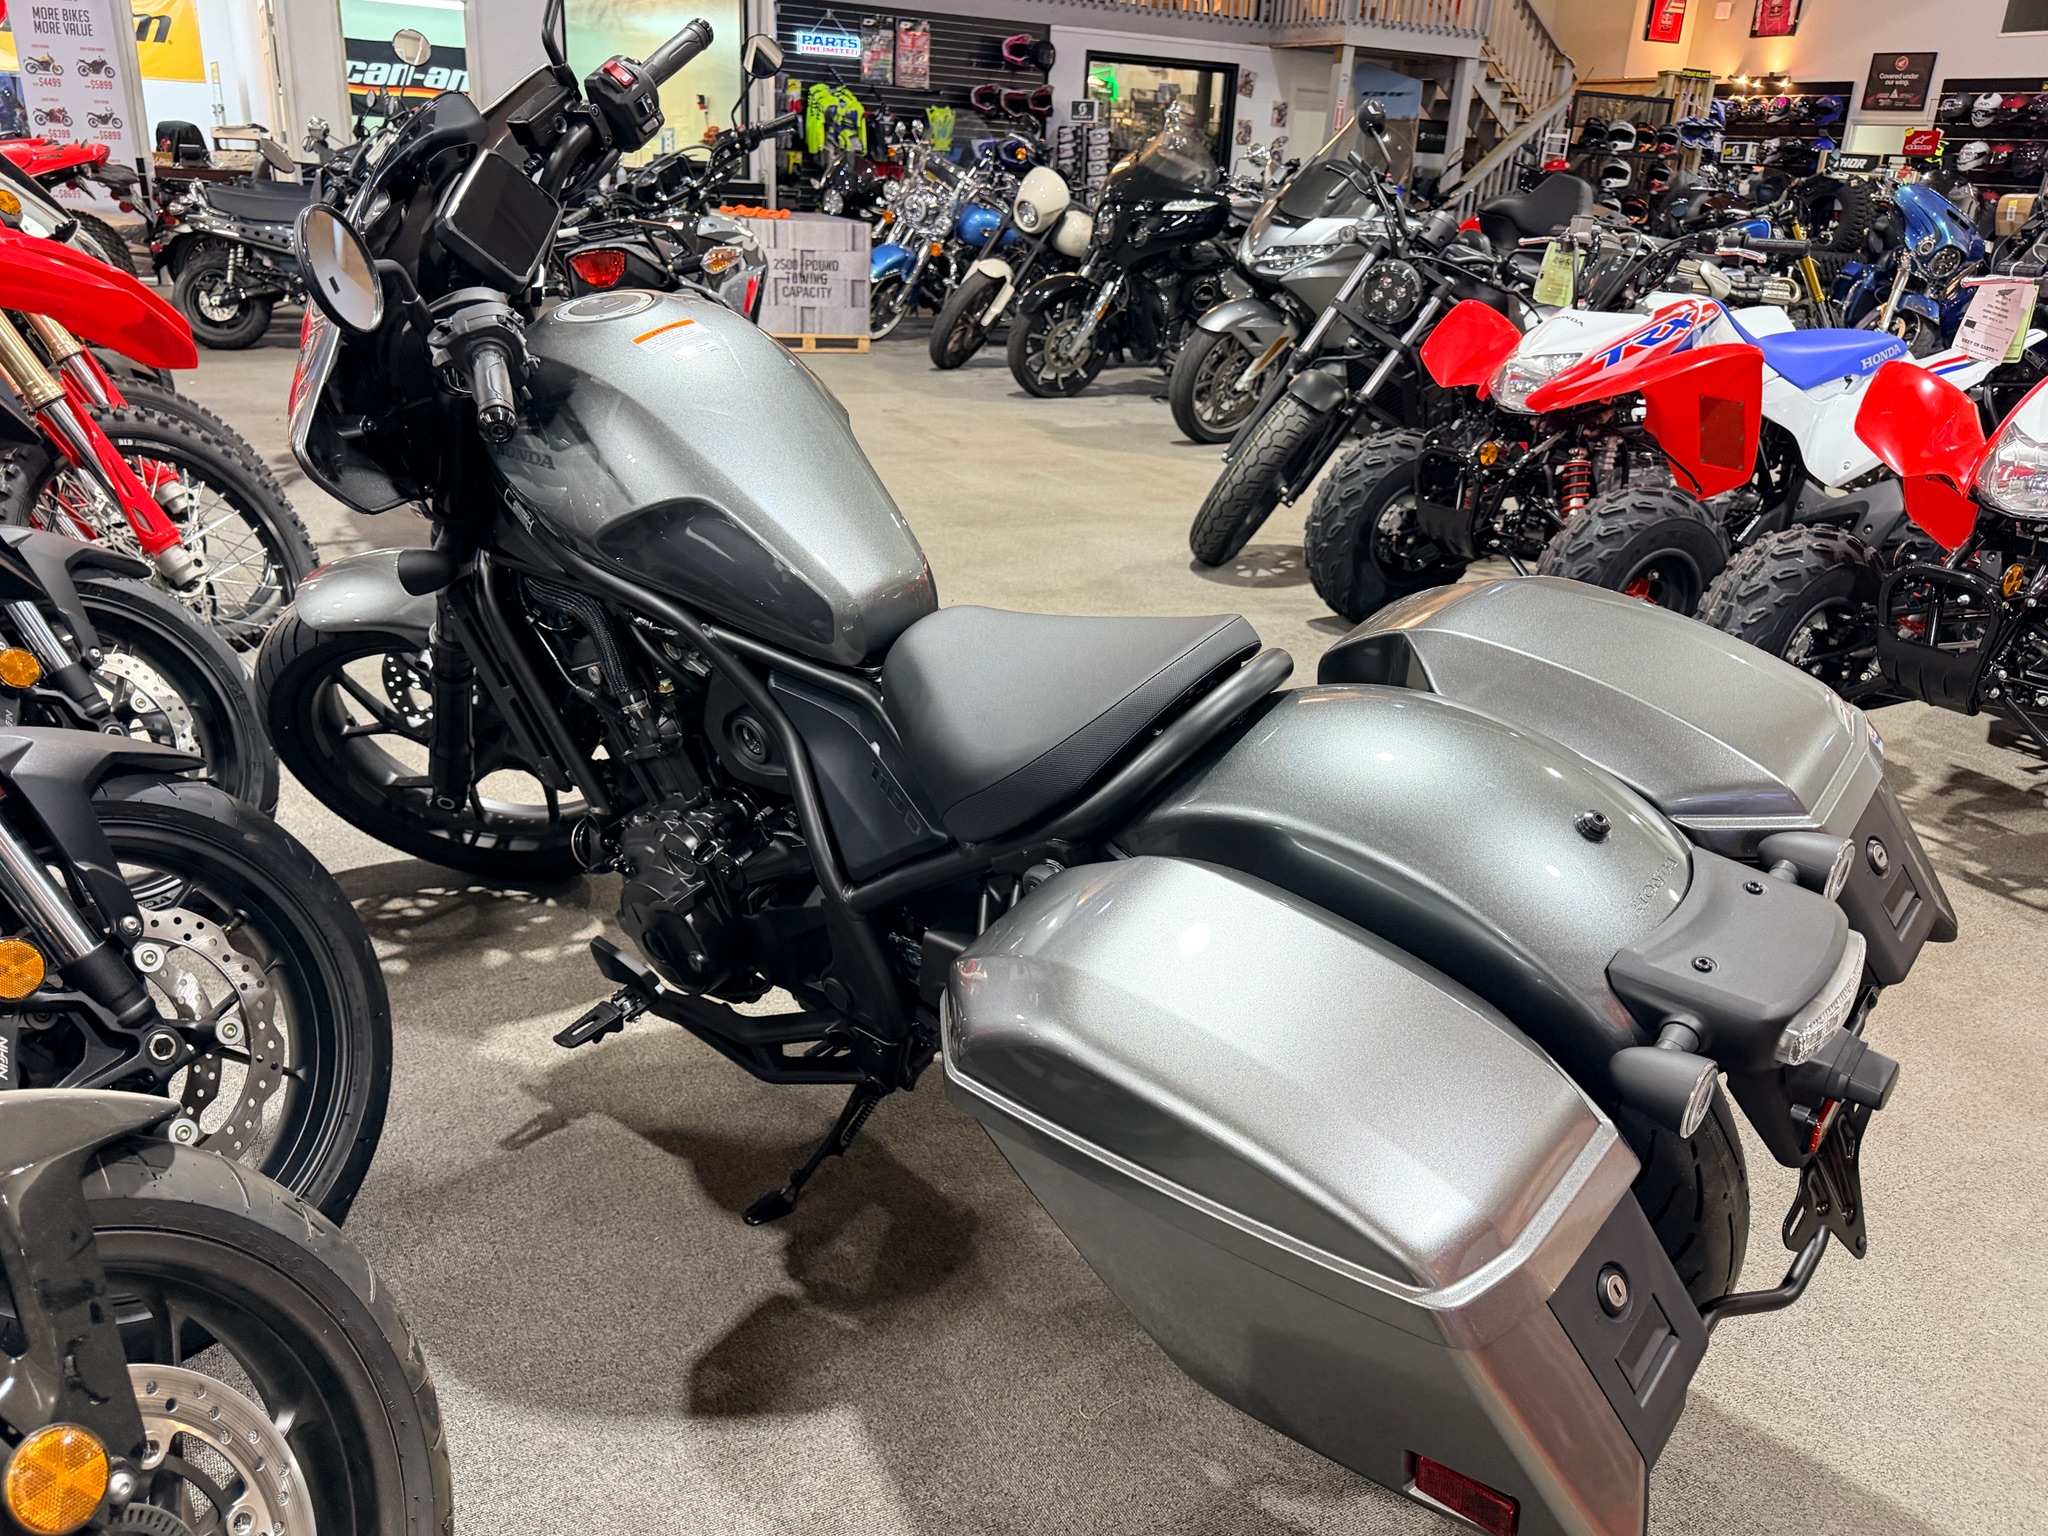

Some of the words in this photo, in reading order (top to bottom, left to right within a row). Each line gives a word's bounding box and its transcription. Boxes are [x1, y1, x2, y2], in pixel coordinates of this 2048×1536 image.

[32, 6, 60, 20] MORE
[62, 8, 90, 23] BIKES
[33, 20, 61, 35] MORE
[62, 22, 94, 37] VALUE
[801, 45, 858, 55] UNLIMITED
[802, 35, 858, 48] PARTS
[1879, 72, 1902, 80] Covered
[785, 272, 828, 285] TOWING
[782, 286, 832, 299] CAPACITY
[1594, 309, 1697, 369] TRX
[1861, 344, 1902, 370] HONDA
[495, 444, 556, 470] HONDA
[1629, 857, 1678, 915] HONDA
